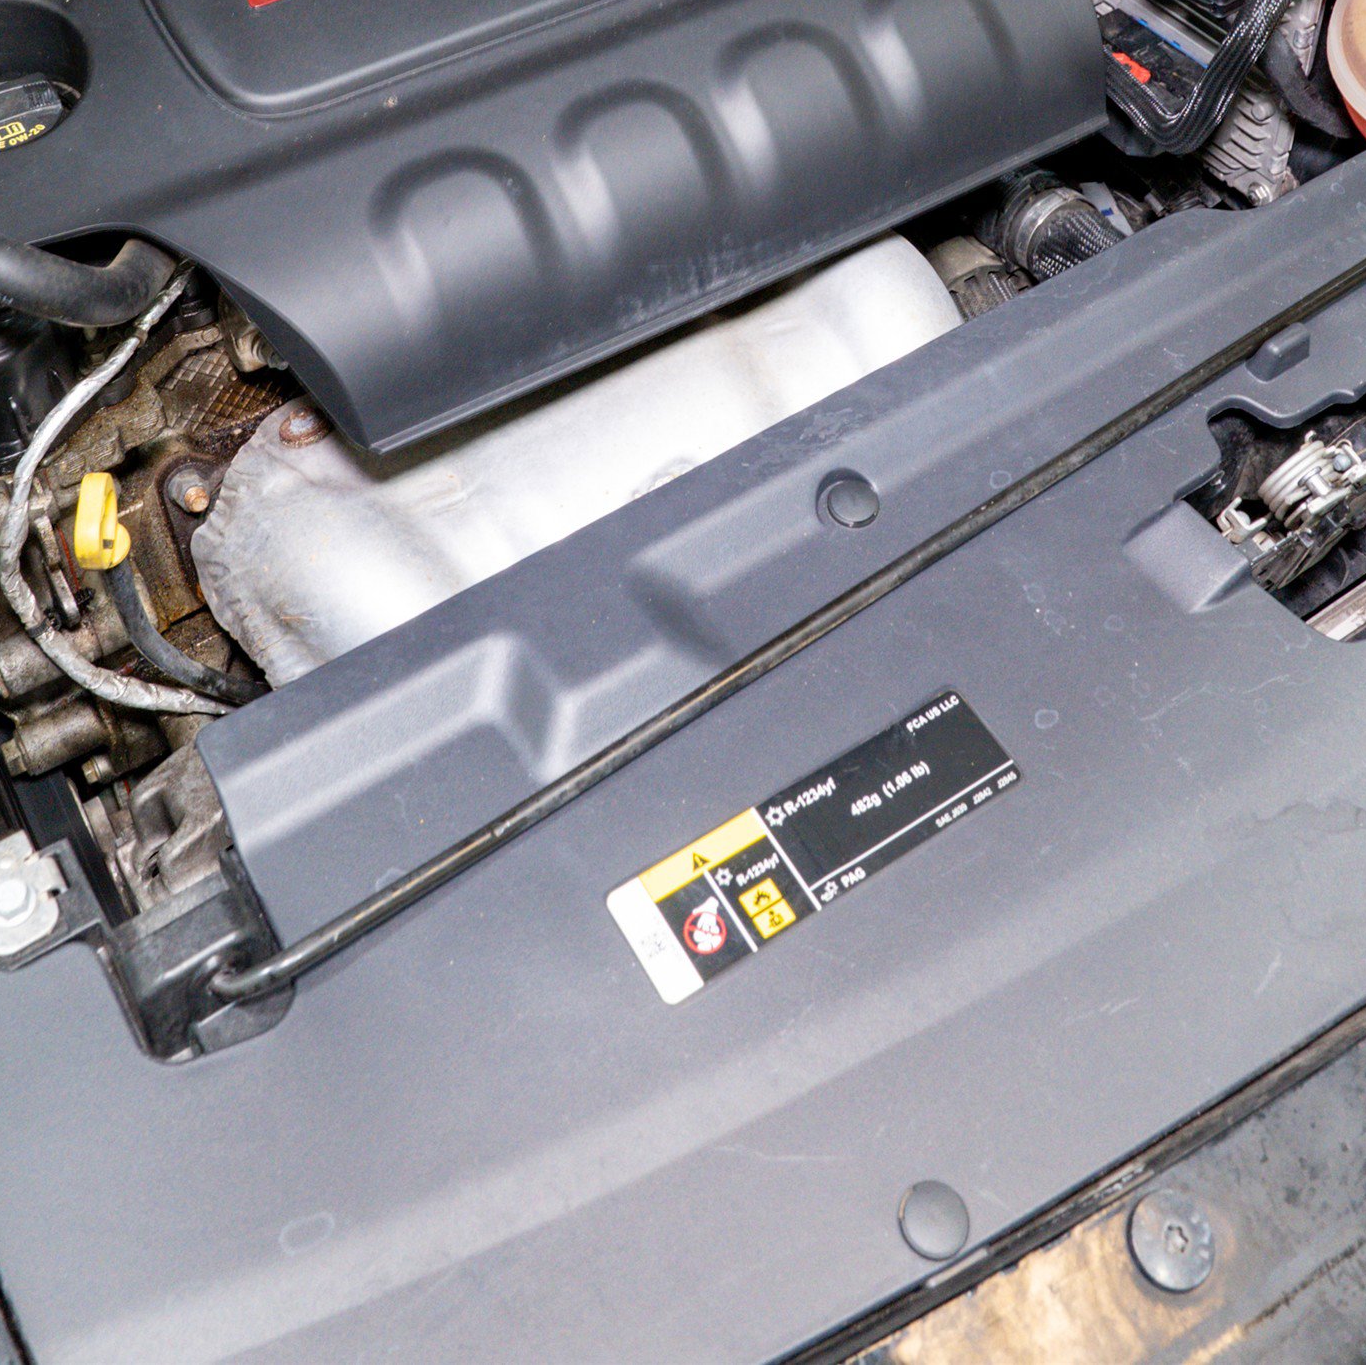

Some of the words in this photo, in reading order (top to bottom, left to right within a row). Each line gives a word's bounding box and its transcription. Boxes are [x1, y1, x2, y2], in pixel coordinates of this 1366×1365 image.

[906, 714, 928, 733] FCA
[925, 706, 942, 721] US
[939, 695, 959, 713] LLC
[783, 776, 836, 816] R-1234yf
[850, 792, 882, 816] 482g
[882, 771, 913, 799] (1.06
[909, 760, 931, 779] lb)
[935, 812, 953, 828] SAE
[840, 866, 866, 888] PAG
